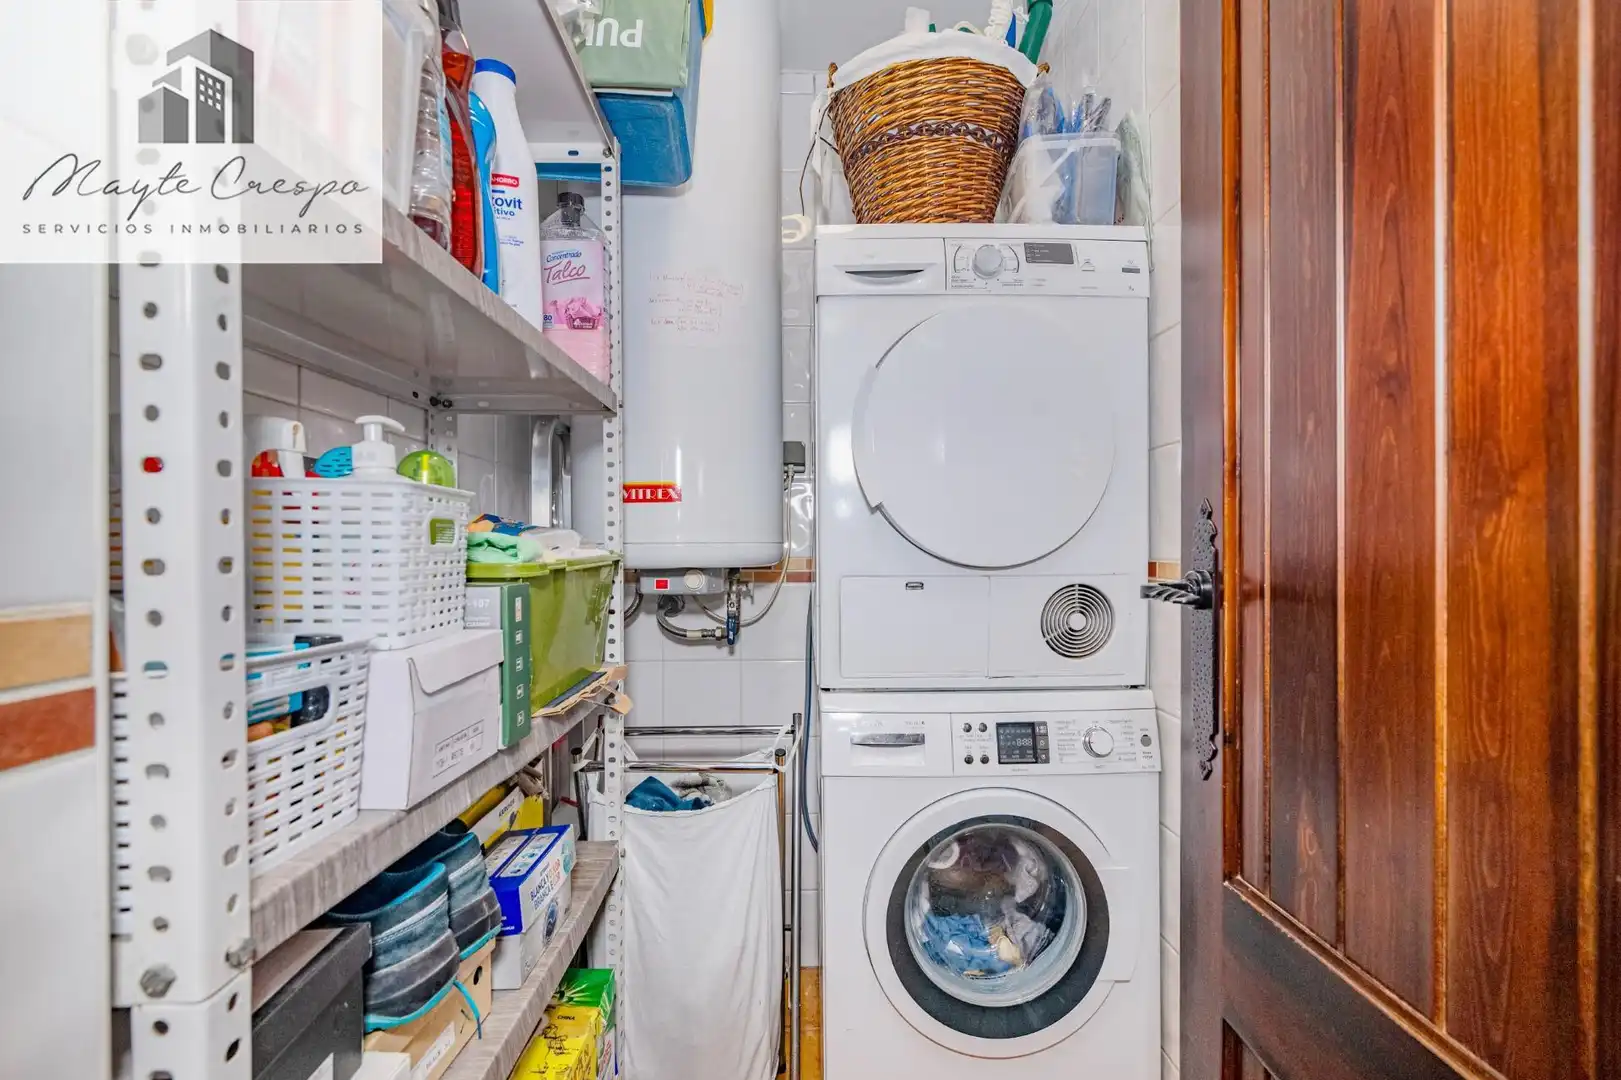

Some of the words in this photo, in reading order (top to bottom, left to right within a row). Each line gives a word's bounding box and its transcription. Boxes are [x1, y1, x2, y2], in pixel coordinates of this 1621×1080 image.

[585, 17, 643, 48] PU
[546, 250, 583, 263] Concentrado
[543, 260, 587, 284] Talco
